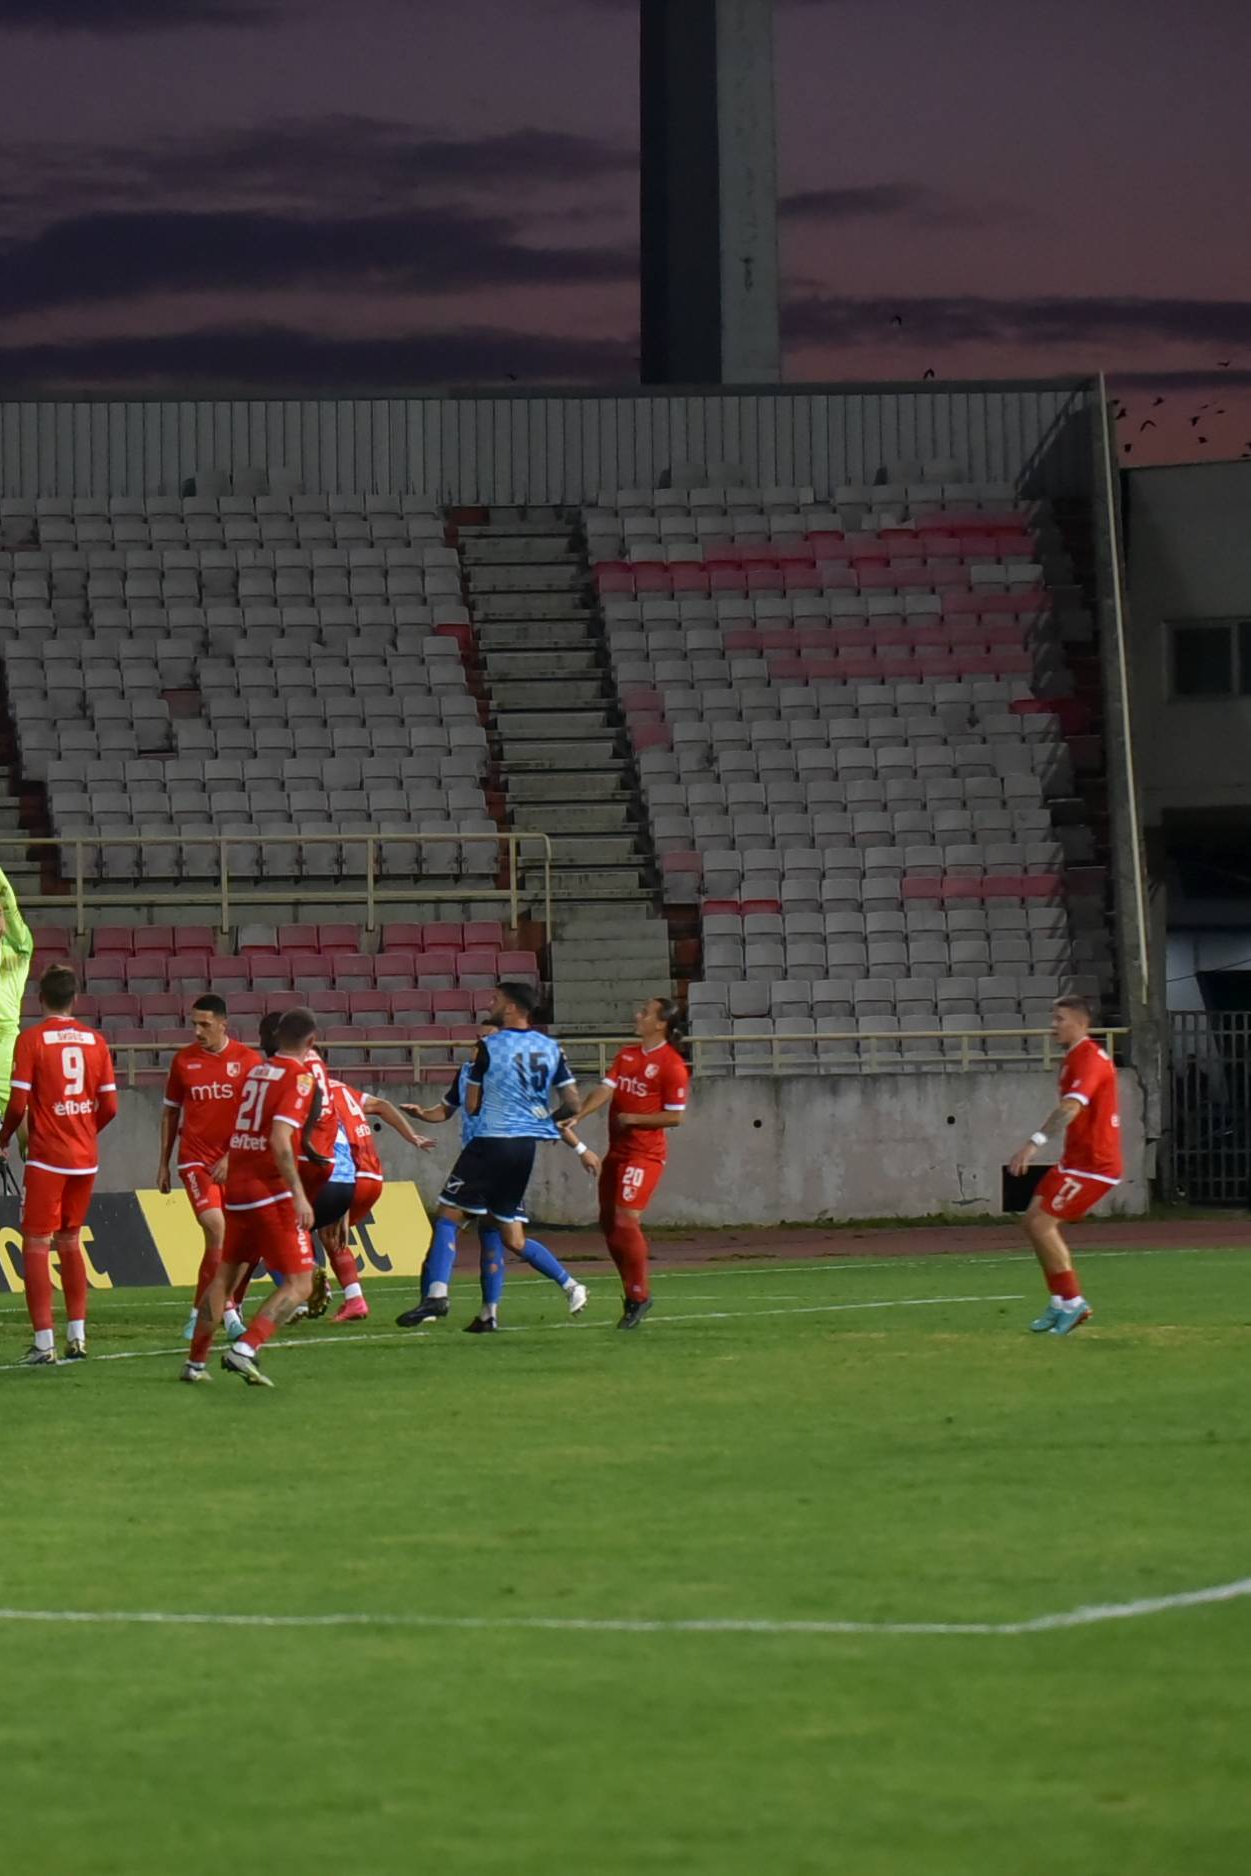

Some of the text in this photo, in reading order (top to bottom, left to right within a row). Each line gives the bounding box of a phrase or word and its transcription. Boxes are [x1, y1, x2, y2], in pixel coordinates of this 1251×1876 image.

[62, 1047, 84, 1095] 9
[191, 1082, 234, 1100] mts
[618, 1075, 648, 1097] mts
[54, 1100, 92, 1116] efbet
[235, 1080, 270, 1132] 21
[342, 1088, 366, 1121] 4
[230, 1134, 268, 1151] efbet
[622, 1167, 644, 1187] 20
